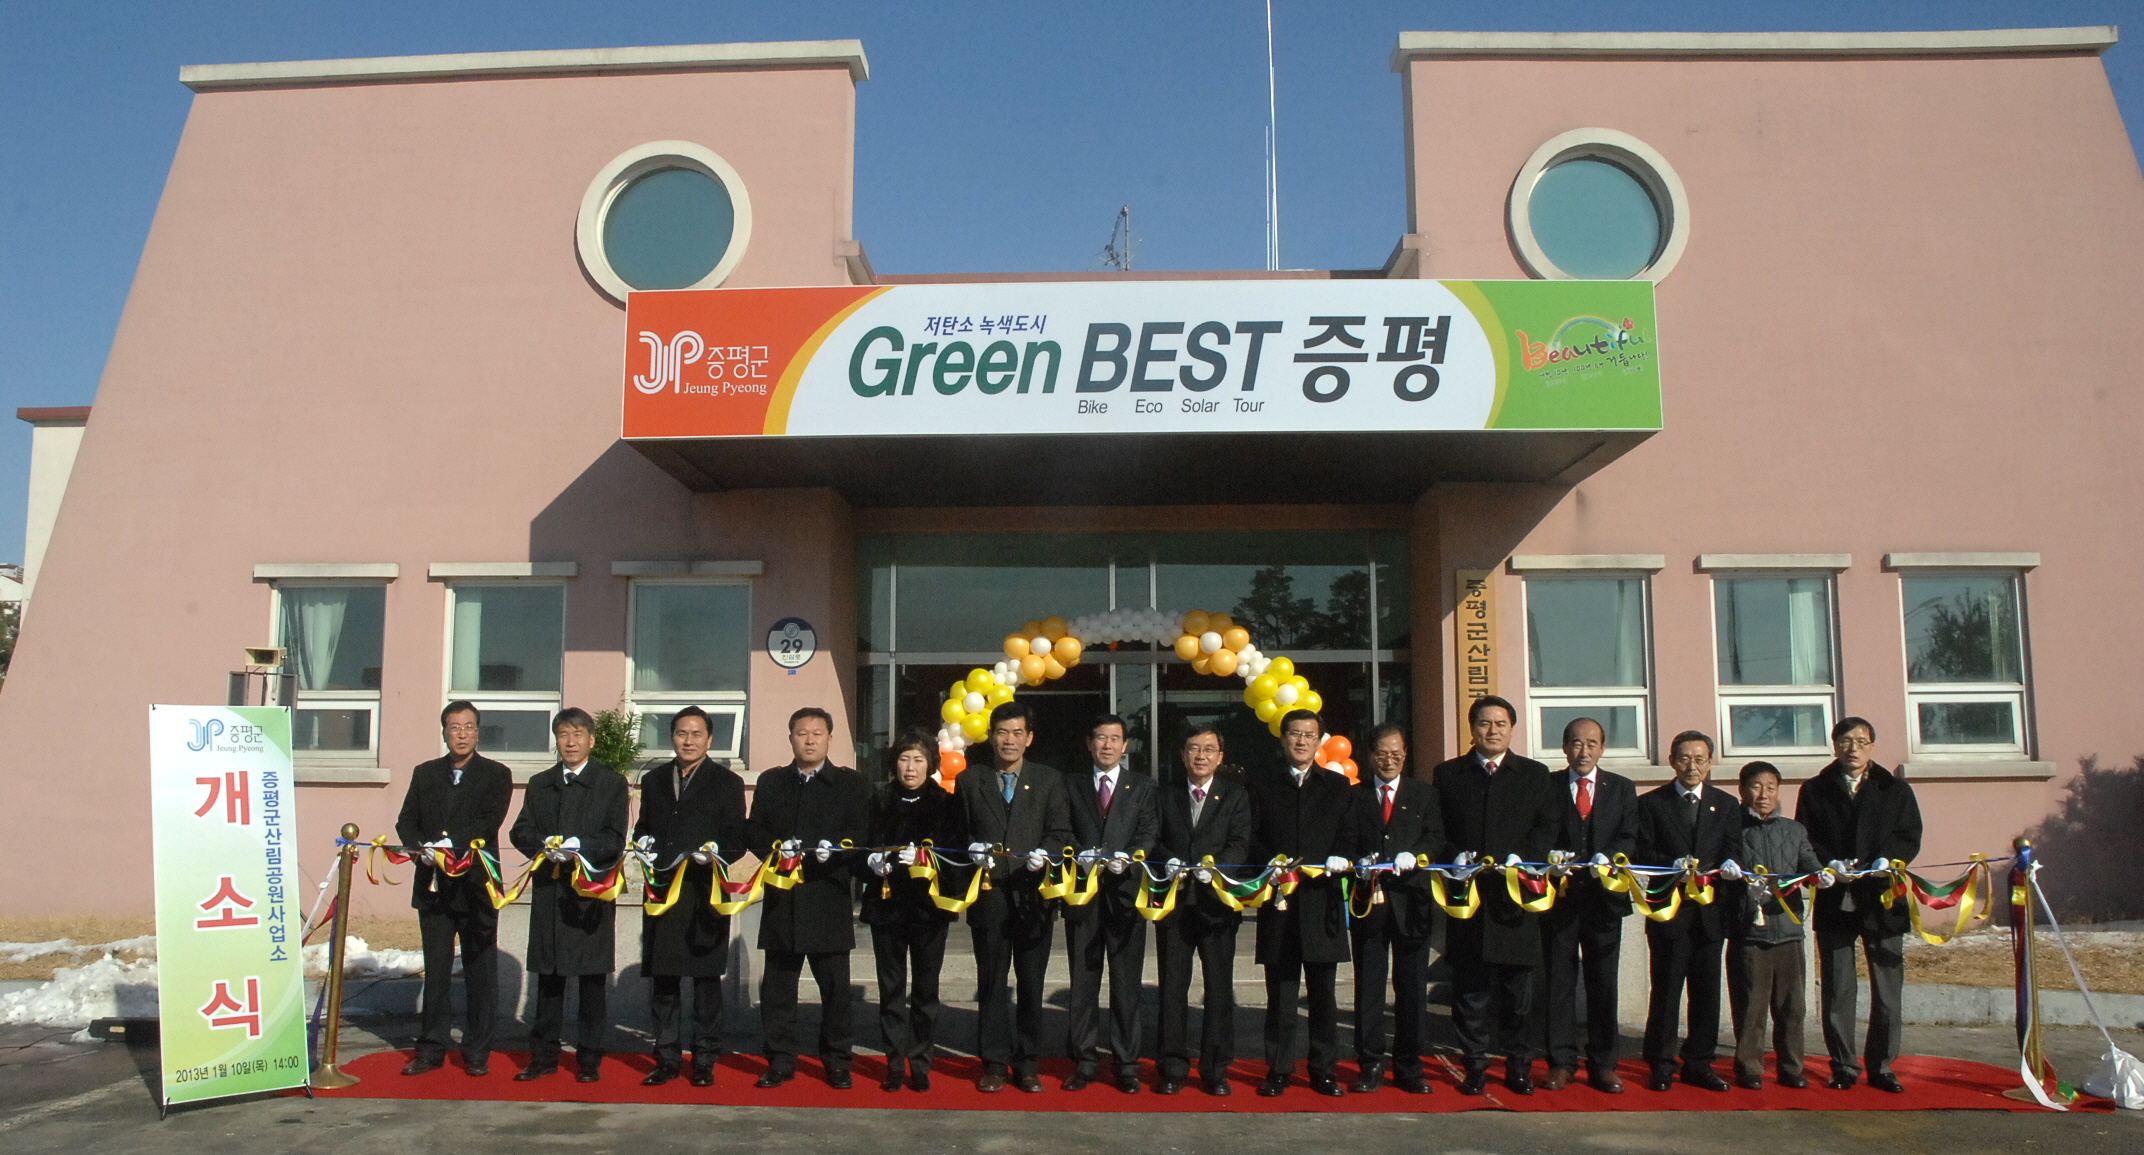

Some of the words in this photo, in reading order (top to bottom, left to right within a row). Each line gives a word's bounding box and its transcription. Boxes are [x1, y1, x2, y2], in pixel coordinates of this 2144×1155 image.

[924, 316, 974, 335] 저탄소
[979, 314, 1048, 335] 녹색도시
[848, 325, 1062, 398] Green
[1076, 320, 1284, 394] BEST
[1292, 315, 1452, 404] 증평
[1516, 328, 1652, 370] Beautiful
[706, 345, 769, 379] 증평군
[682, 381, 719, 397] Jeung
[722, 380, 768, 397] Pyeong
[1077, 399, 1109, 416] Bike
[1134, 398, 1164, 415] Eco
[1180, 397, 1221, 414] Solar
[1233, 397, 1265, 413] Tour
[780, 639, 803, 653] 29
[229, 725, 264, 744] 증평군
[216, 745, 237, 753] Jeung
[238, 744, 265, 753] Pyeong
[261, 771, 289, 963] 증평군산림공원사업소
[194, 770, 260, 1038] 개소식
[175, 1067, 210, 1083] 2013년
[213, 1065, 228, 1079] 1월
[231, 1059, 268, 1076] 10일(목)
[273, 1056, 299, 1070] 14:00
